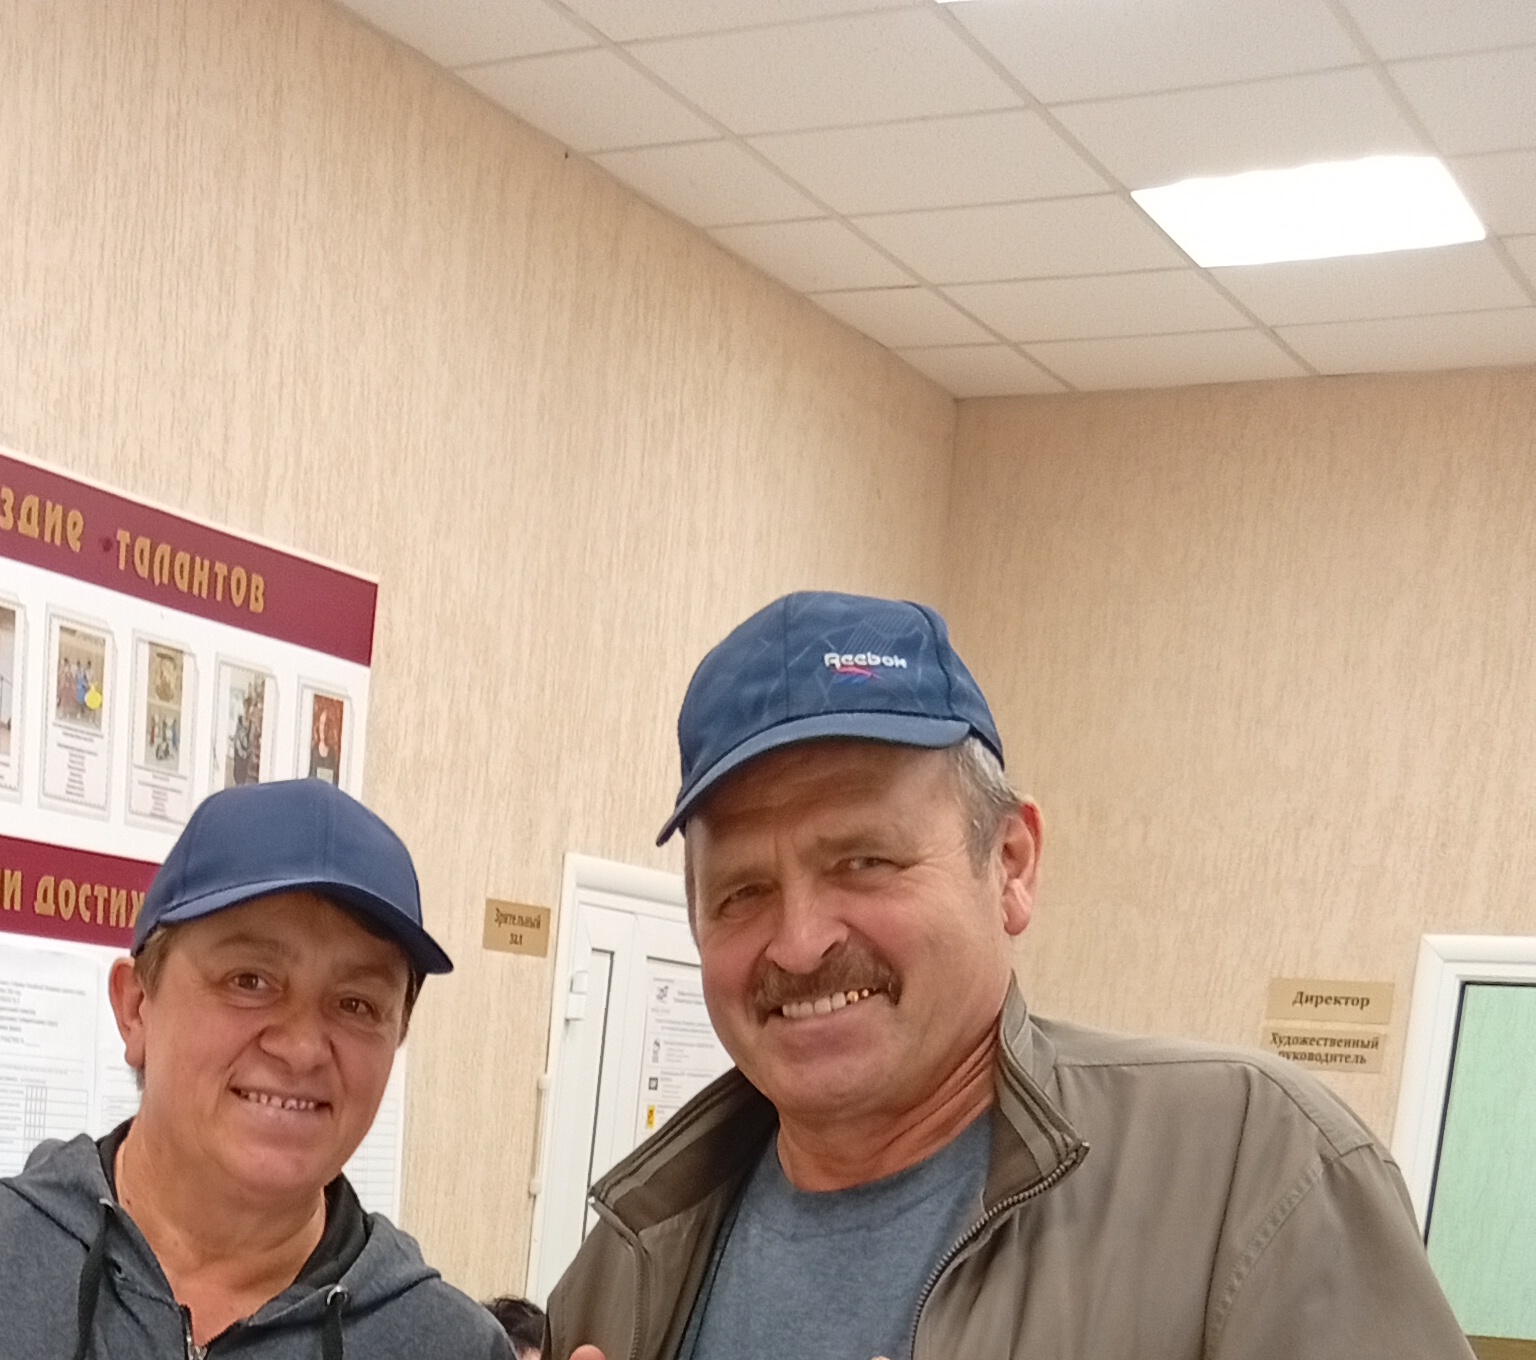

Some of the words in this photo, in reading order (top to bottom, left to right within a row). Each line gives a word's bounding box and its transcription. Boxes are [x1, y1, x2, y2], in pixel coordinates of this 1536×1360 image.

[115, 528, 269, 615] талантов
[824, 651, 907, 669] Reebok
[494, 907, 542, 929] Зрительный
[509, 933, 523, 946] зал
[1292, 991, 1370, 1010] Директор
[1270, 1032, 1379, 1050] Художественный
